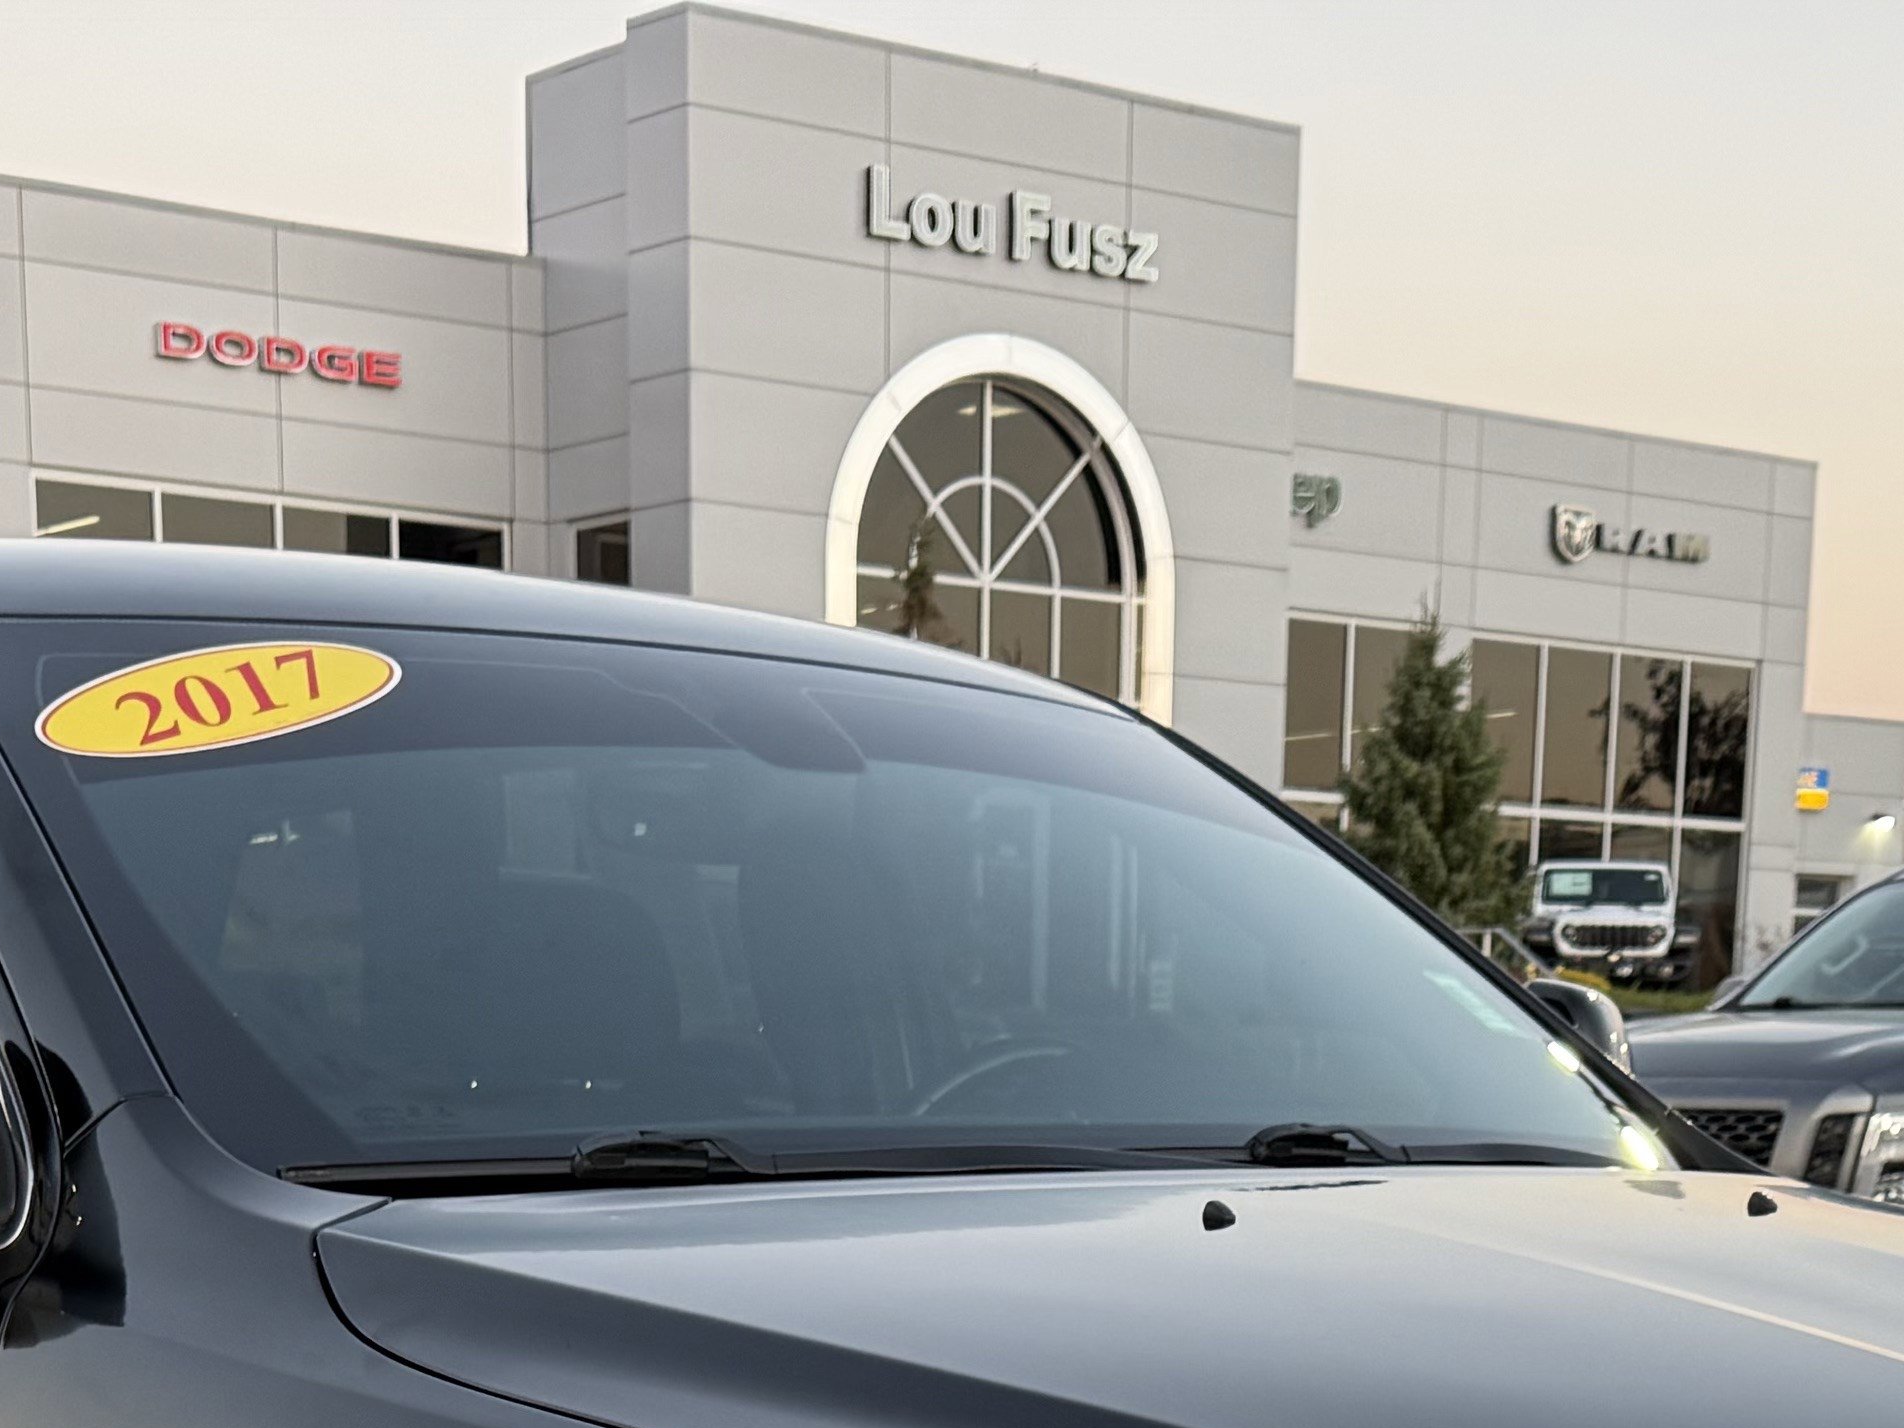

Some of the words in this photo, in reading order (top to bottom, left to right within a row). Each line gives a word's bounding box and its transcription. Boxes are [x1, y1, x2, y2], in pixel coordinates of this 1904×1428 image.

[867, 163, 996, 254] Lou
[1010, 188, 1160, 284] Fusz
[154, 320, 403, 389] DODGE
[1595, 523, 1711, 565] RAM
[114, 648, 321, 747] 2017
